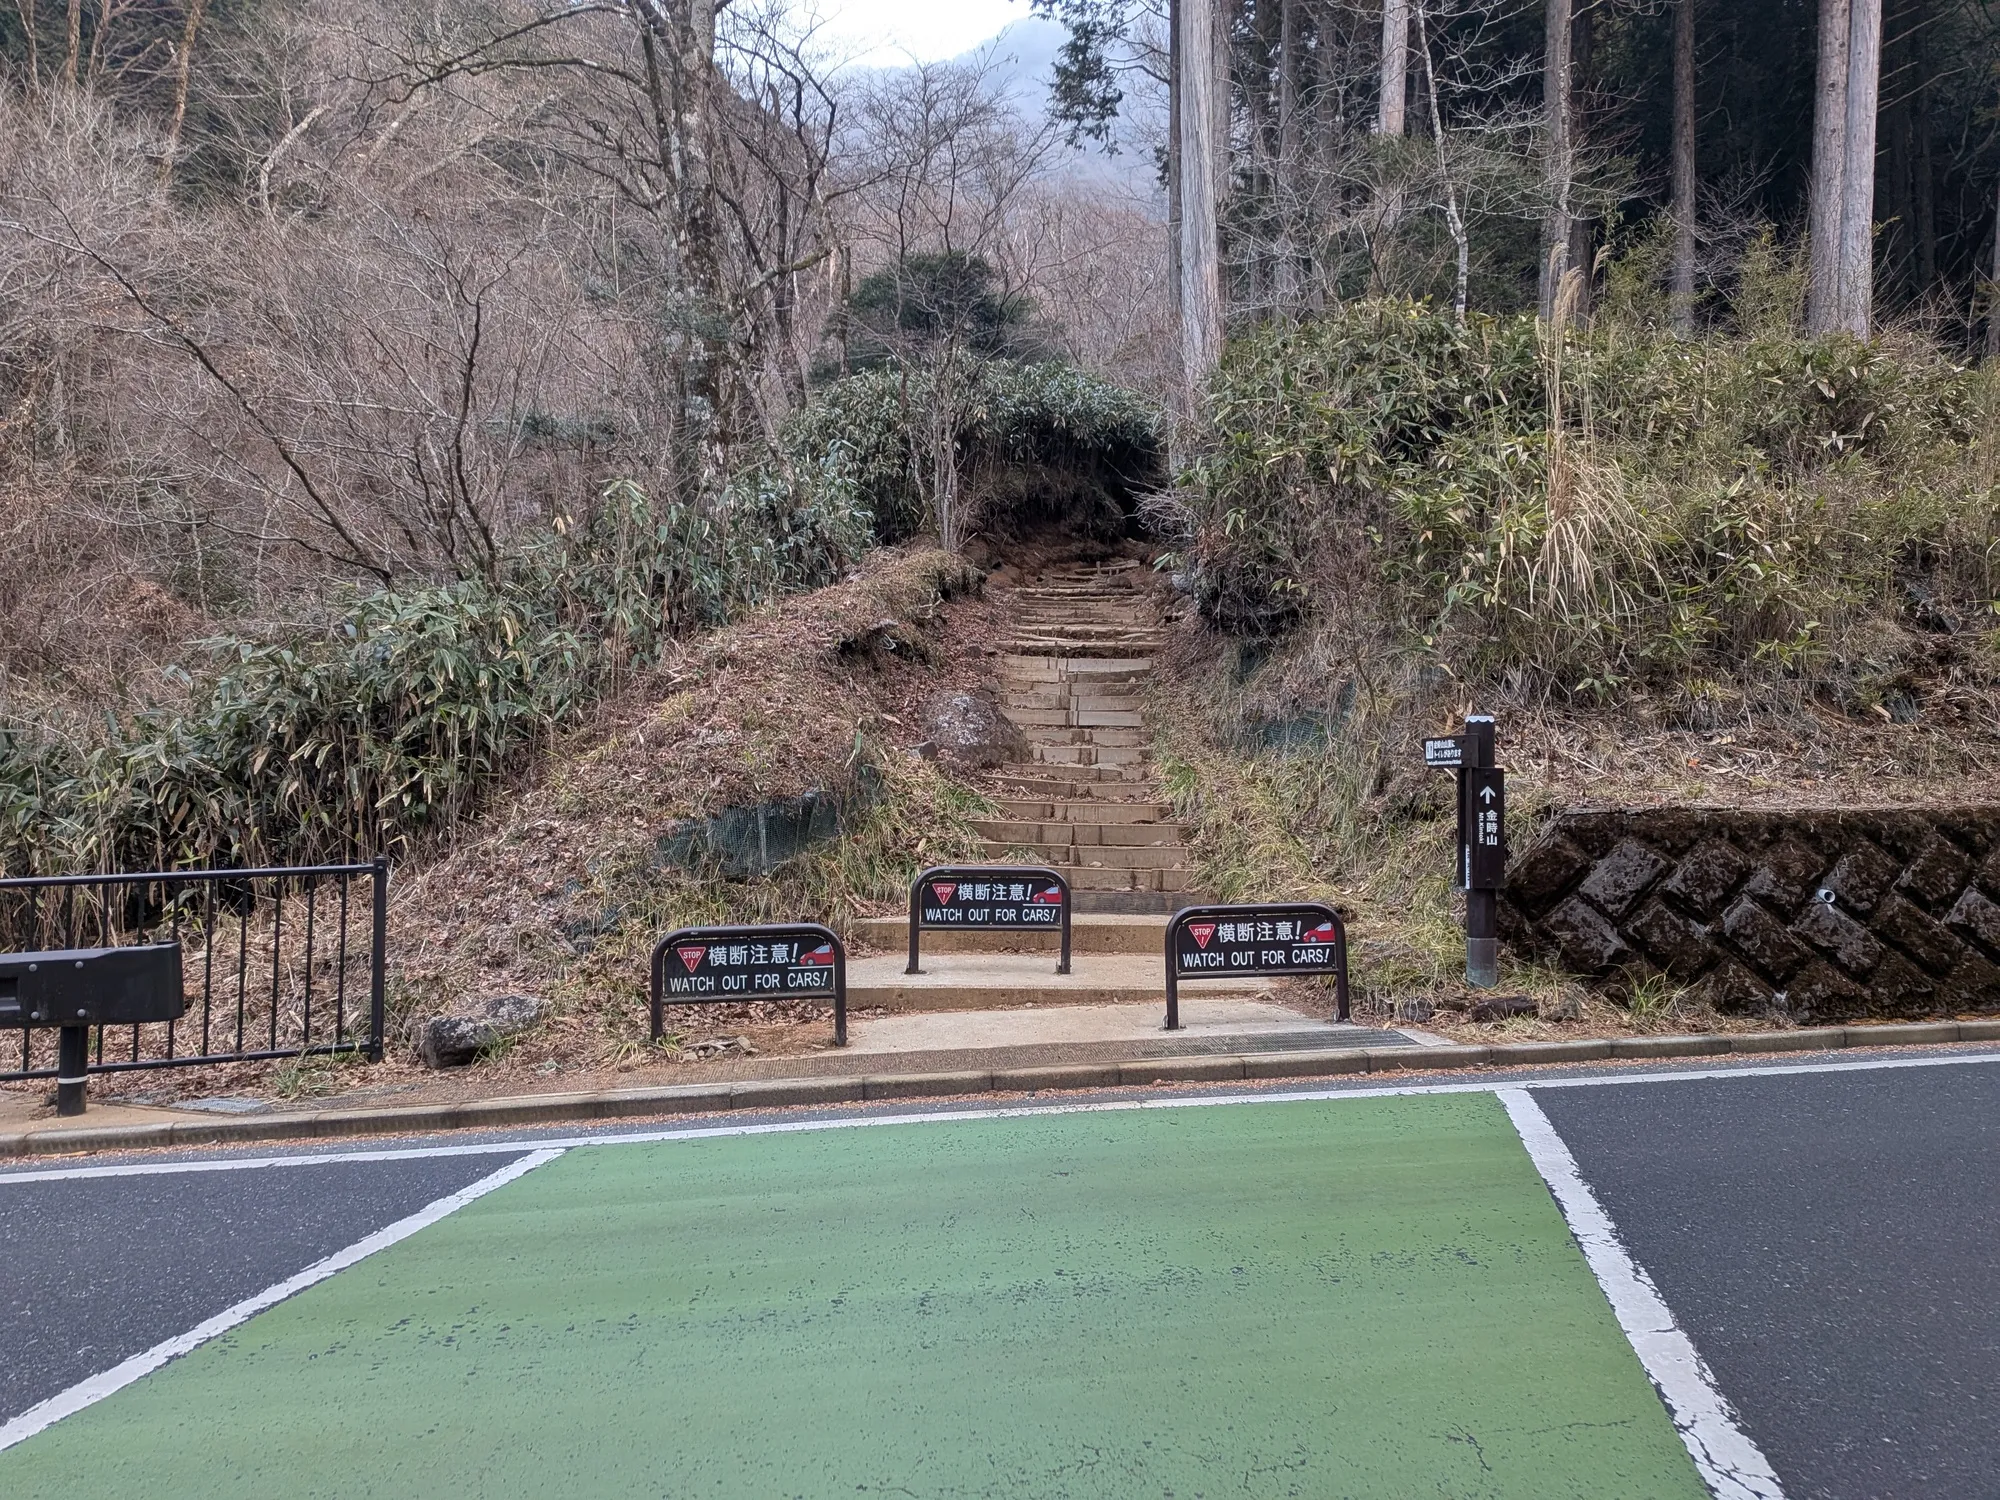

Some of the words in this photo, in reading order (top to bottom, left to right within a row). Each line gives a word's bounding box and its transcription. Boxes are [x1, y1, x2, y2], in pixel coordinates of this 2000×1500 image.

[1486, 810, 1498, 846] 金時山
[958, 884, 1032, 901] 横断注意!
[926, 908, 962, 921] WATCH
[968, 908, 990, 921] OUT
[996, 908, 1016, 921] FOR
[1022, 909, 1056, 922] CARS!
[1218, 920, 1301, 943] 横断注意!
[708, 943, 799, 966] 横断注意!
[1183, 952, 1224, 967] WATCH
[1231, 951, 1254, 966] OUT
[1262, 950, 1285, 965] FOR
[1292, 948, 1329, 964] CARS!
[670, 976, 714, 992] WATCH
[722, 975, 747, 990] OUT
[755, 974, 780, 989] FOR
[788, 971, 828, 987] CARS!
